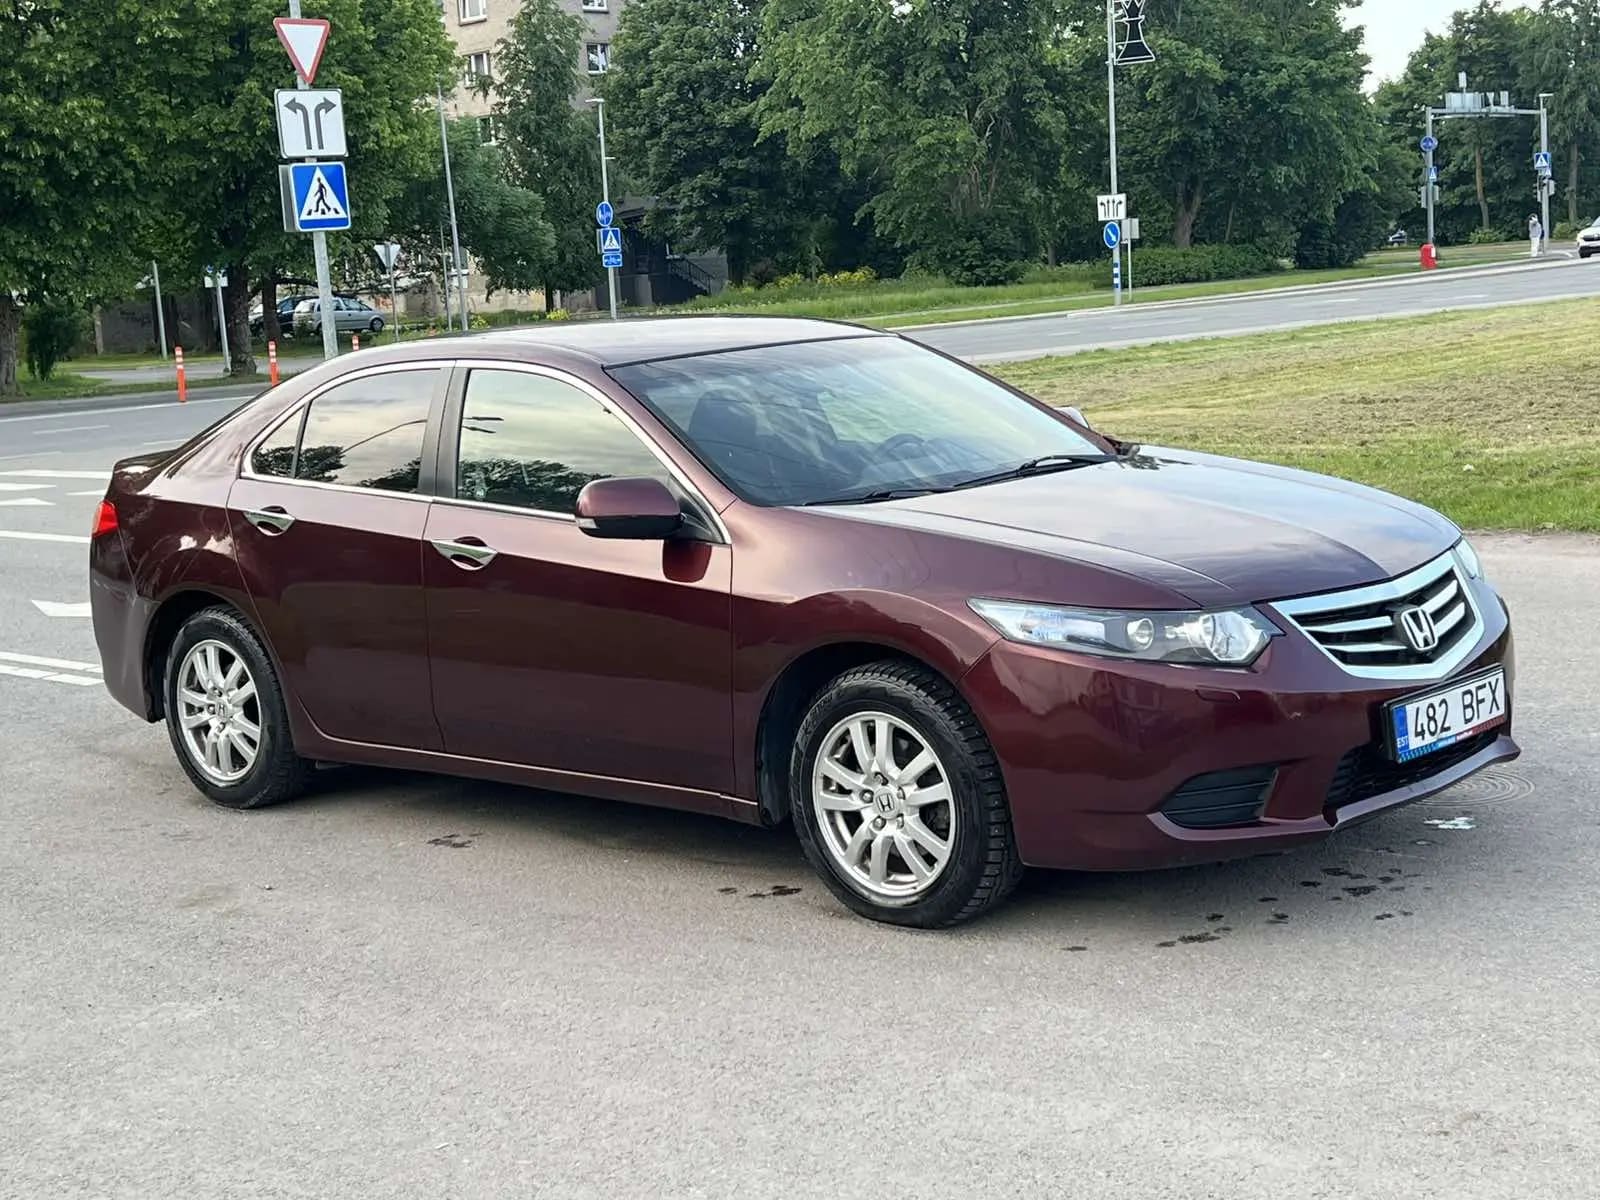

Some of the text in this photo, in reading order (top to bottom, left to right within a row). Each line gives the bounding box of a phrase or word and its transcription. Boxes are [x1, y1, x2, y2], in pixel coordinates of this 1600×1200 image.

[1414, 698, 1451, 740] 482
[1461, 678, 1500, 724] BFX
[1397, 735, 1409, 748] EST
